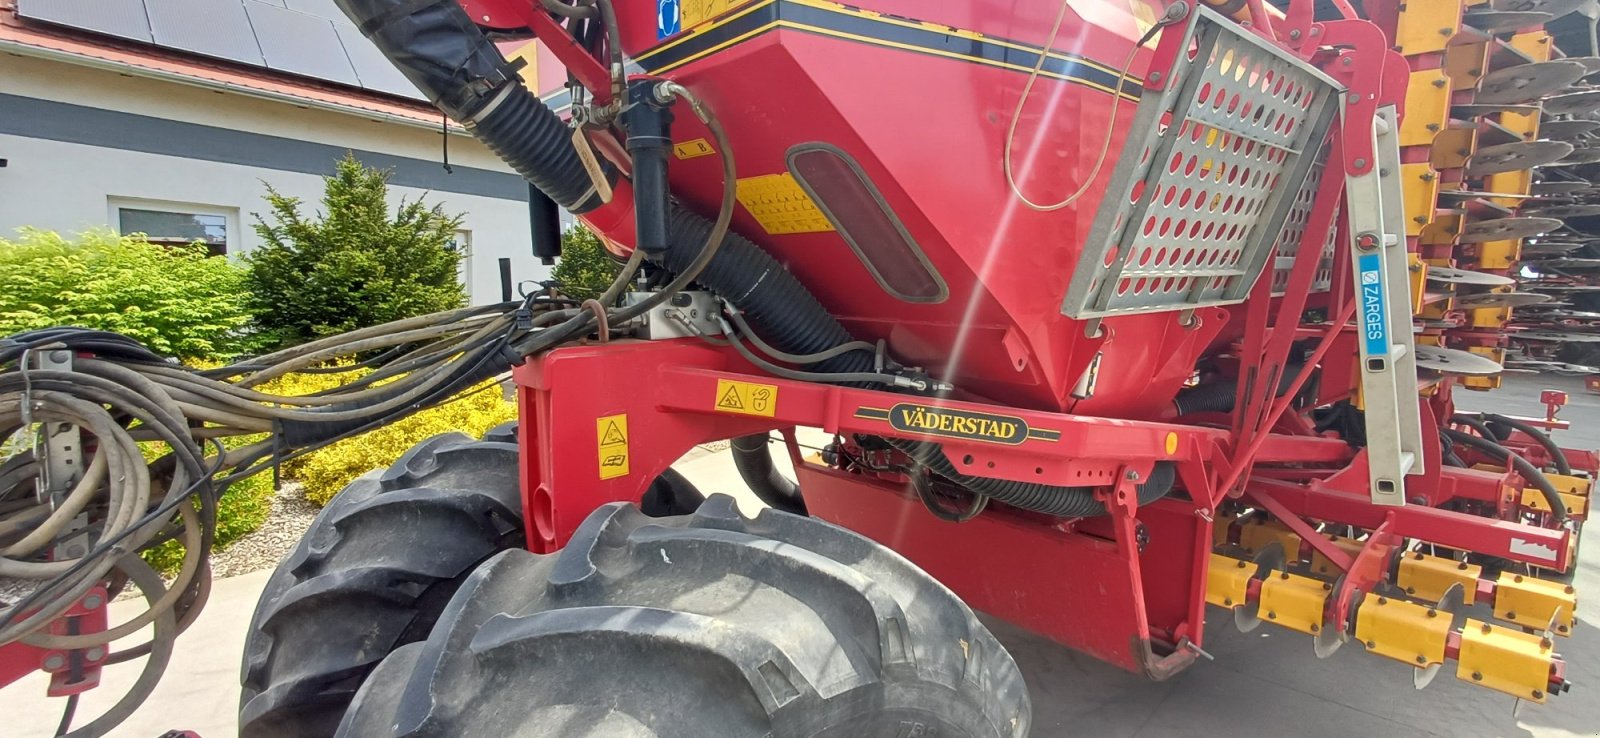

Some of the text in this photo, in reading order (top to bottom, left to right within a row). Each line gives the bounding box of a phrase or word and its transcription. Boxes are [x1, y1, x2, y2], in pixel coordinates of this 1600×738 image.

[678, 142, 707, 156] A B
[1364, 286, 1382, 340] ZARGES
[902, 407, 1016, 438] VÄDERSTAD
